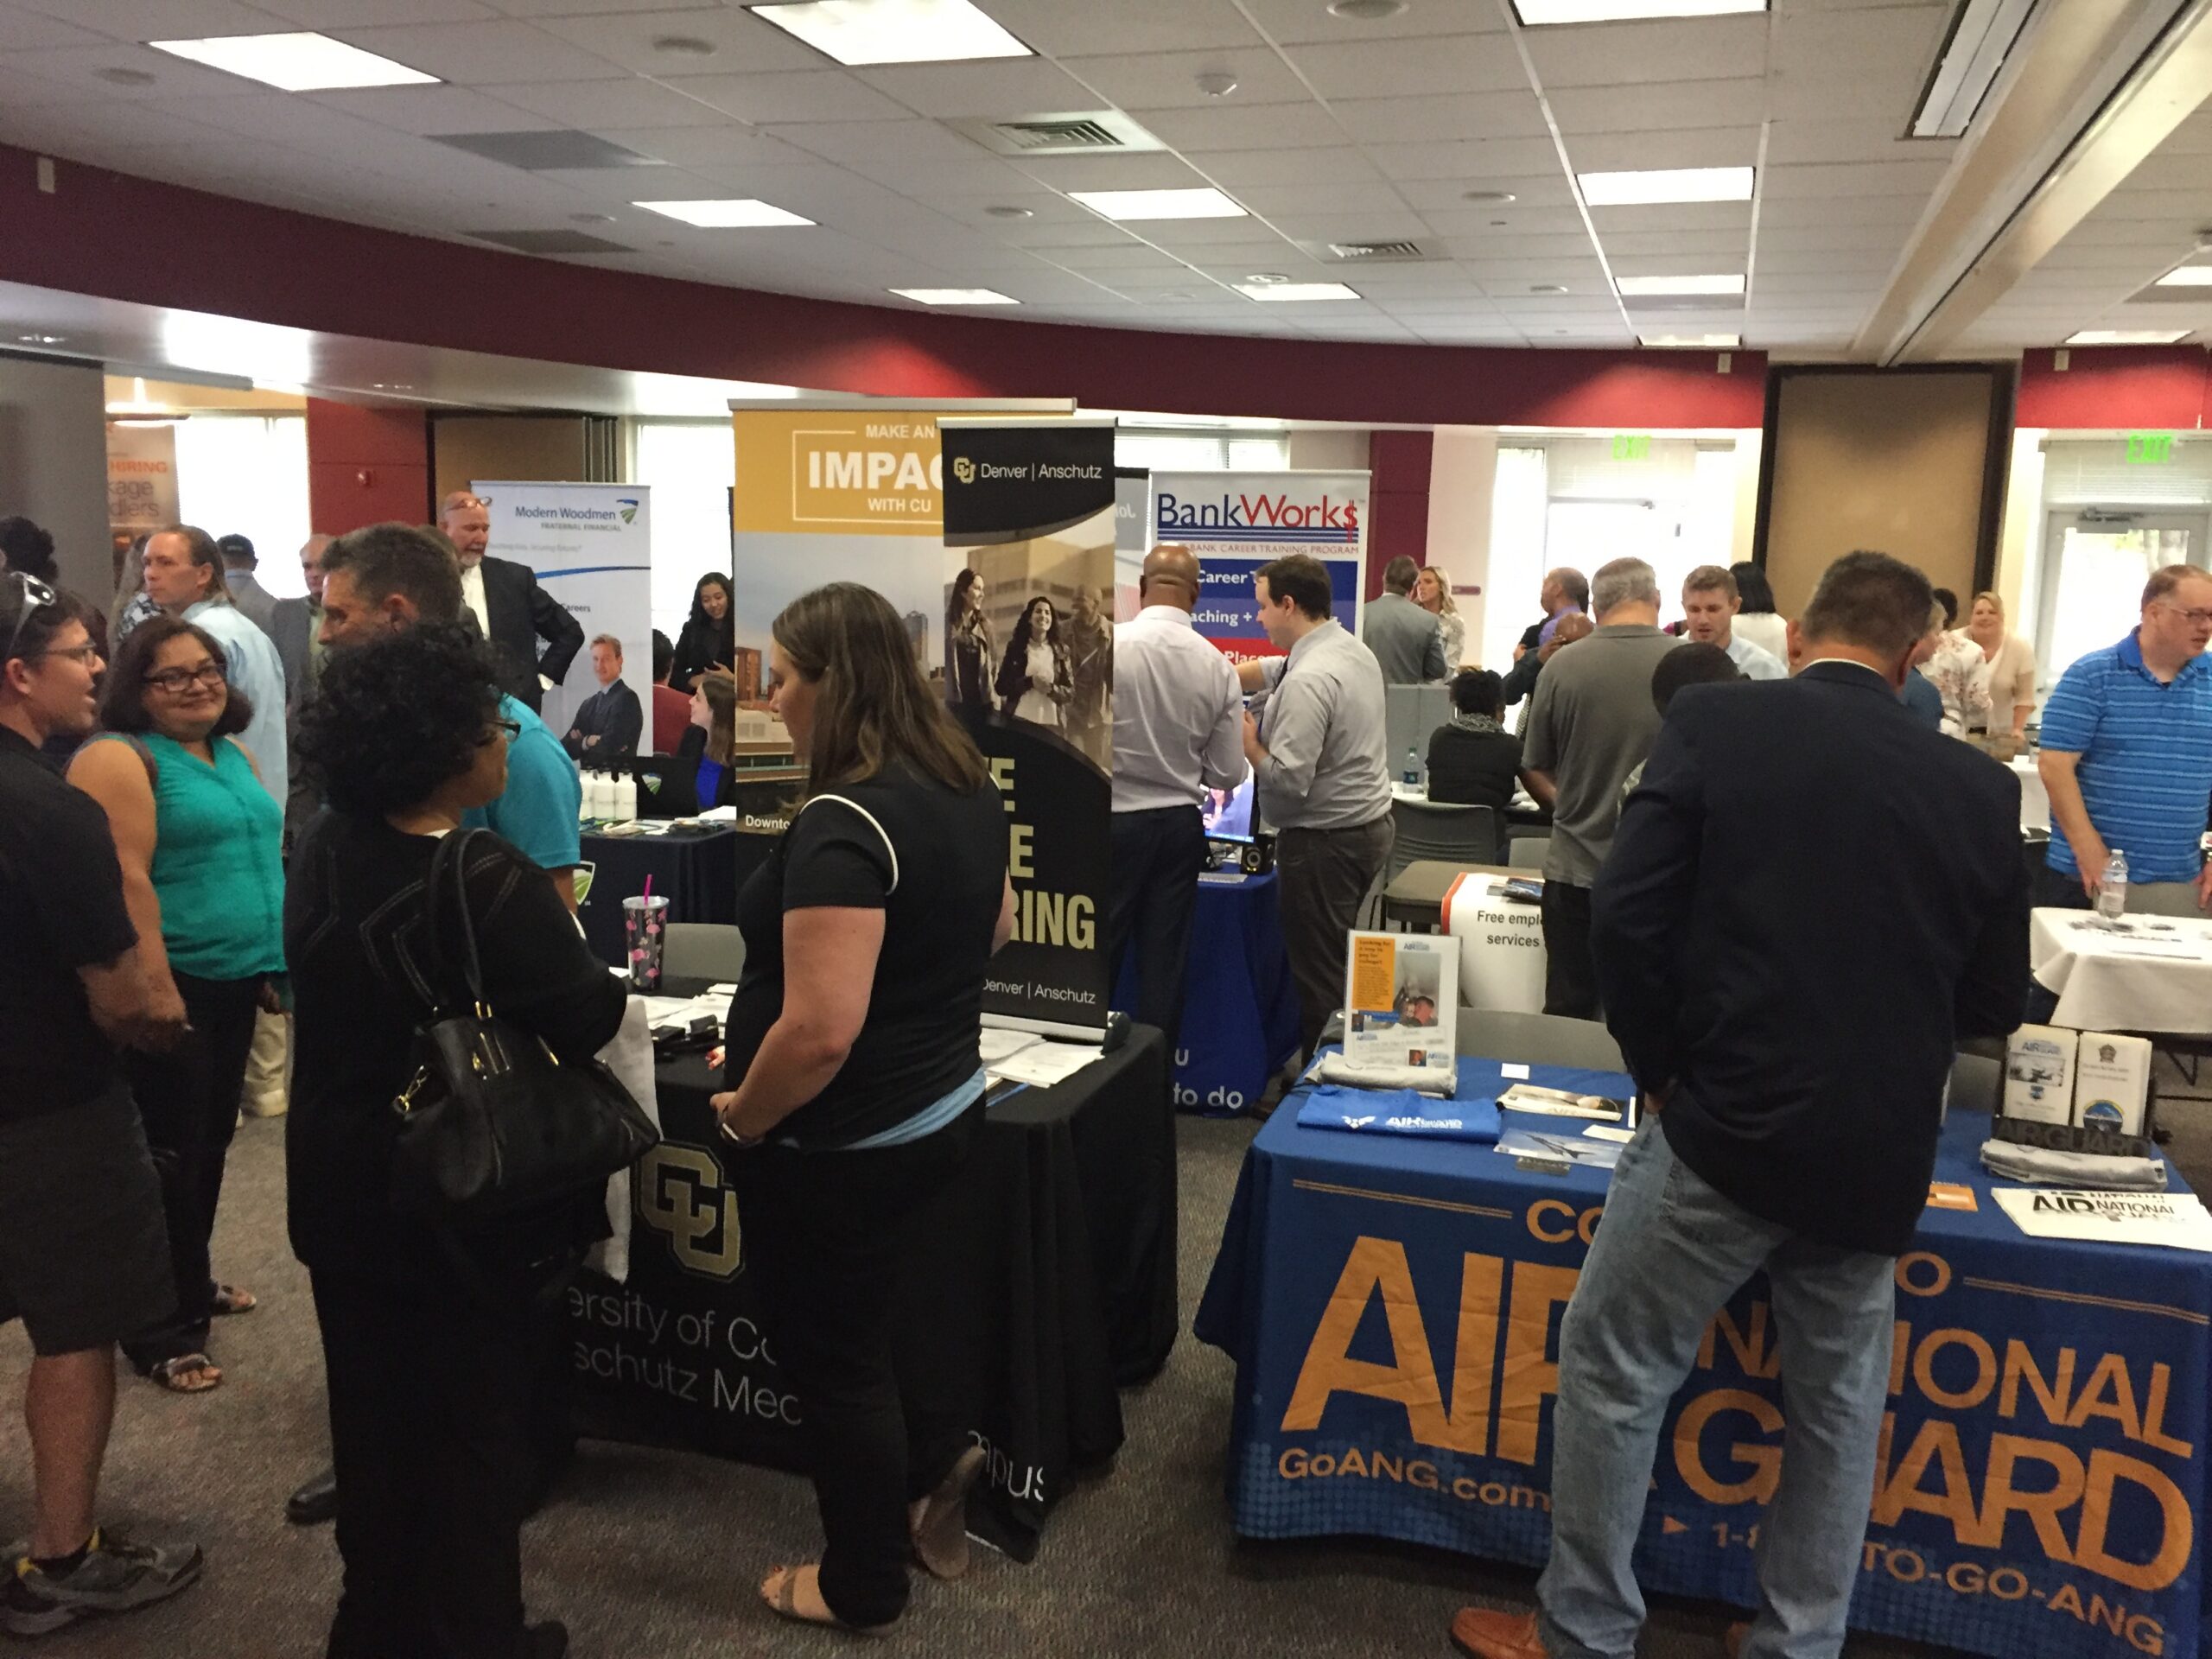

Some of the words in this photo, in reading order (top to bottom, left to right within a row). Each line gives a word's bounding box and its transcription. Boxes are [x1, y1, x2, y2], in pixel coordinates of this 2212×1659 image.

[866, 424, 909, 439] MAKE
[912, 425, 935, 439] AN
[1612, 435, 1652, 460] EXIT
[2127, 435, 2171, 463] EXIT
[981, 462, 1027, 478] Denver
[1039, 463, 1103, 480] Anschutz
[515, 506, 557, 518] Modern
[559, 507, 616, 520] Woodmen
[868, 498, 905, 512] WITH
[910, 498, 931, 512] CU
[541, 523, 582, 531] FRATERNAL
[583, 524, 622, 532] FINANCIAL
[1190, 543, 1217, 553] BANK
[1220, 544, 1257, 554] CAREER
[1258, 544, 1308, 555] TRAINING
[1310, 546, 1359, 555] PROGRAM
[1198, 570, 1249, 584] Career
[1477, 910, 1505, 924] Free
[1508, 913, 1543, 928] empl
[1486, 933, 1541, 948] services
[1033, 983, 1096, 1005] Anschutz
[1173, 1082, 1198, 1106] to
[1207, 1085, 1243, 1109] do
[677, 1309, 716, 1350] of
[1278, 1446, 1553, 1514] GoANG.com
